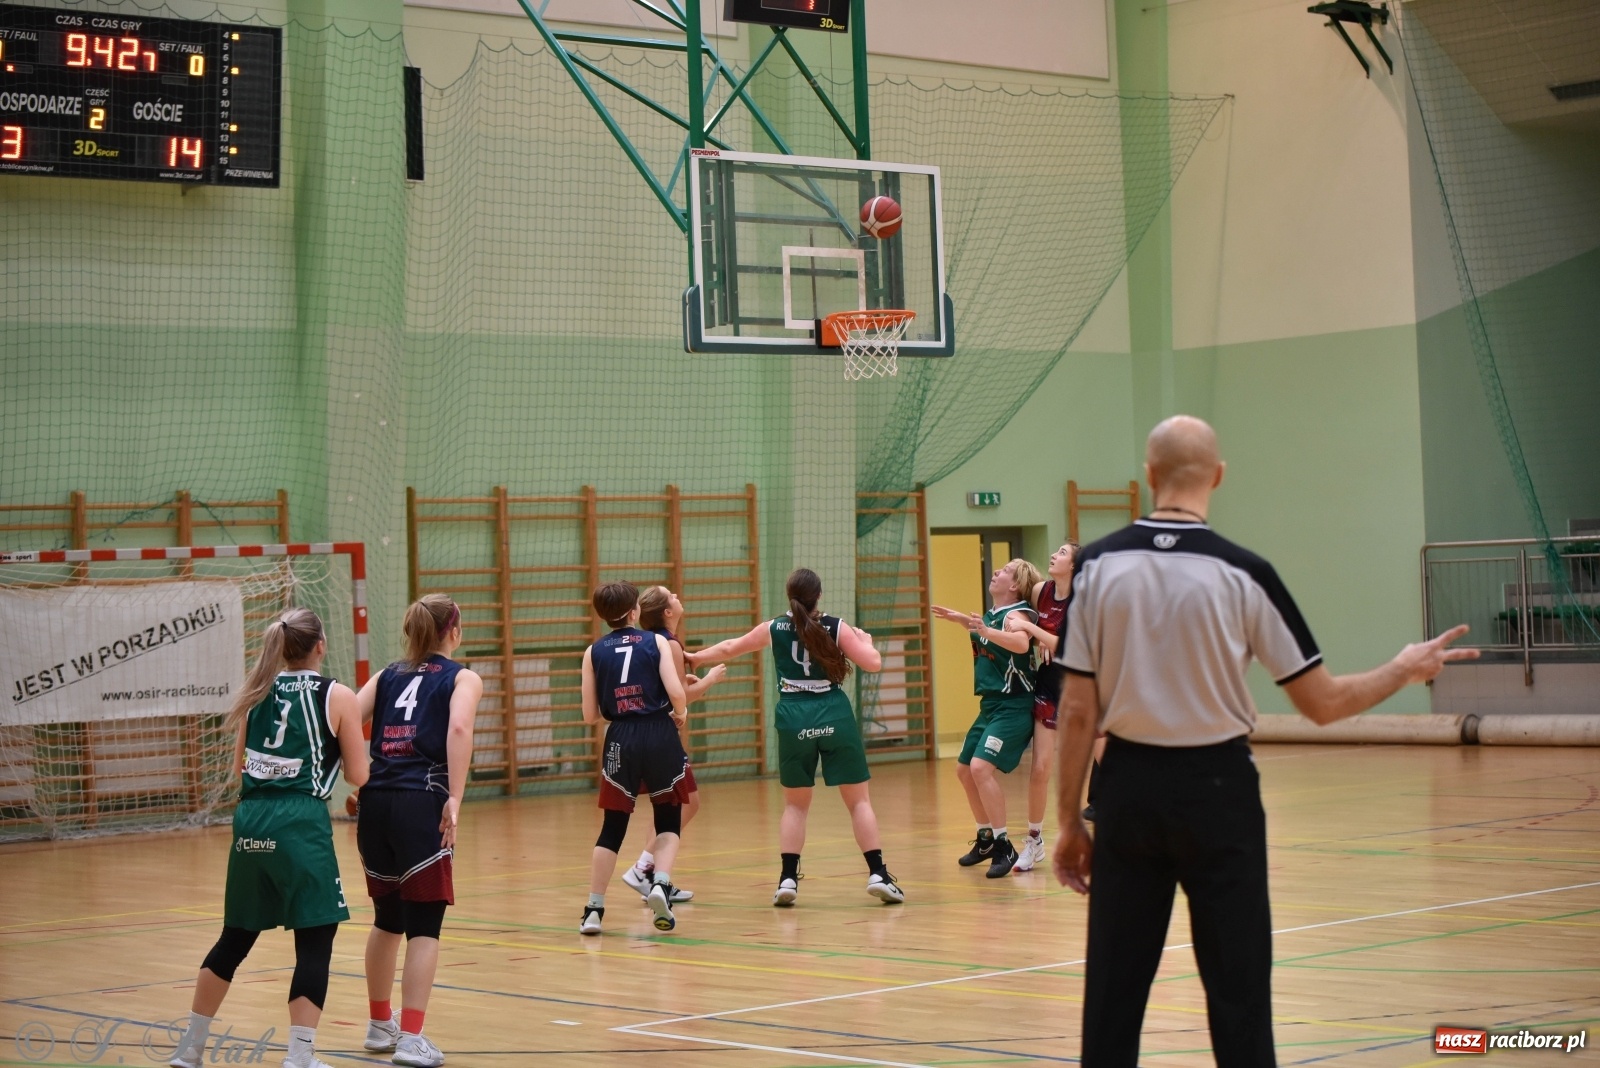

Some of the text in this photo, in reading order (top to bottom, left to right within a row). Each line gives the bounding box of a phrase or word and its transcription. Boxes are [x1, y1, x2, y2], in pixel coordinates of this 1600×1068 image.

[56, 15, 83, 26] CZAS
[91, 17, 117, 29] CZAS
[119, 20, 142, 31] GRY
[189, 55, 204, 76] 0
[223, 65, 229, 73] 7
[222, 76, 228, 84] 8
[222, 88, 228, 96] 9
[89, 98, 106, 106] GRY
[220, 100, 230, 108] 10
[133, 98, 183, 122] GOŚCIE
[220, 111, 229, 119] 11
[89, 108, 105, 130] 2
[220, 134, 230, 142] 13
[169, 137, 201, 168] 14
[220, 145, 229, 153] 14
[219, 157, 228, 165] 15
[776, 622, 791, 631] RKK
[12, 602, 225, 702] JEST W PORZĄDKU!
[614, 645, 633, 684] 7
[101, 683, 229, 702] www.osir-raciborz.pl
[394, 675, 424, 721] 4
[263, 697, 292, 749] 3
[806, 726, 834, 738] Clavis
[243, 838, 276, 850] Clavis
